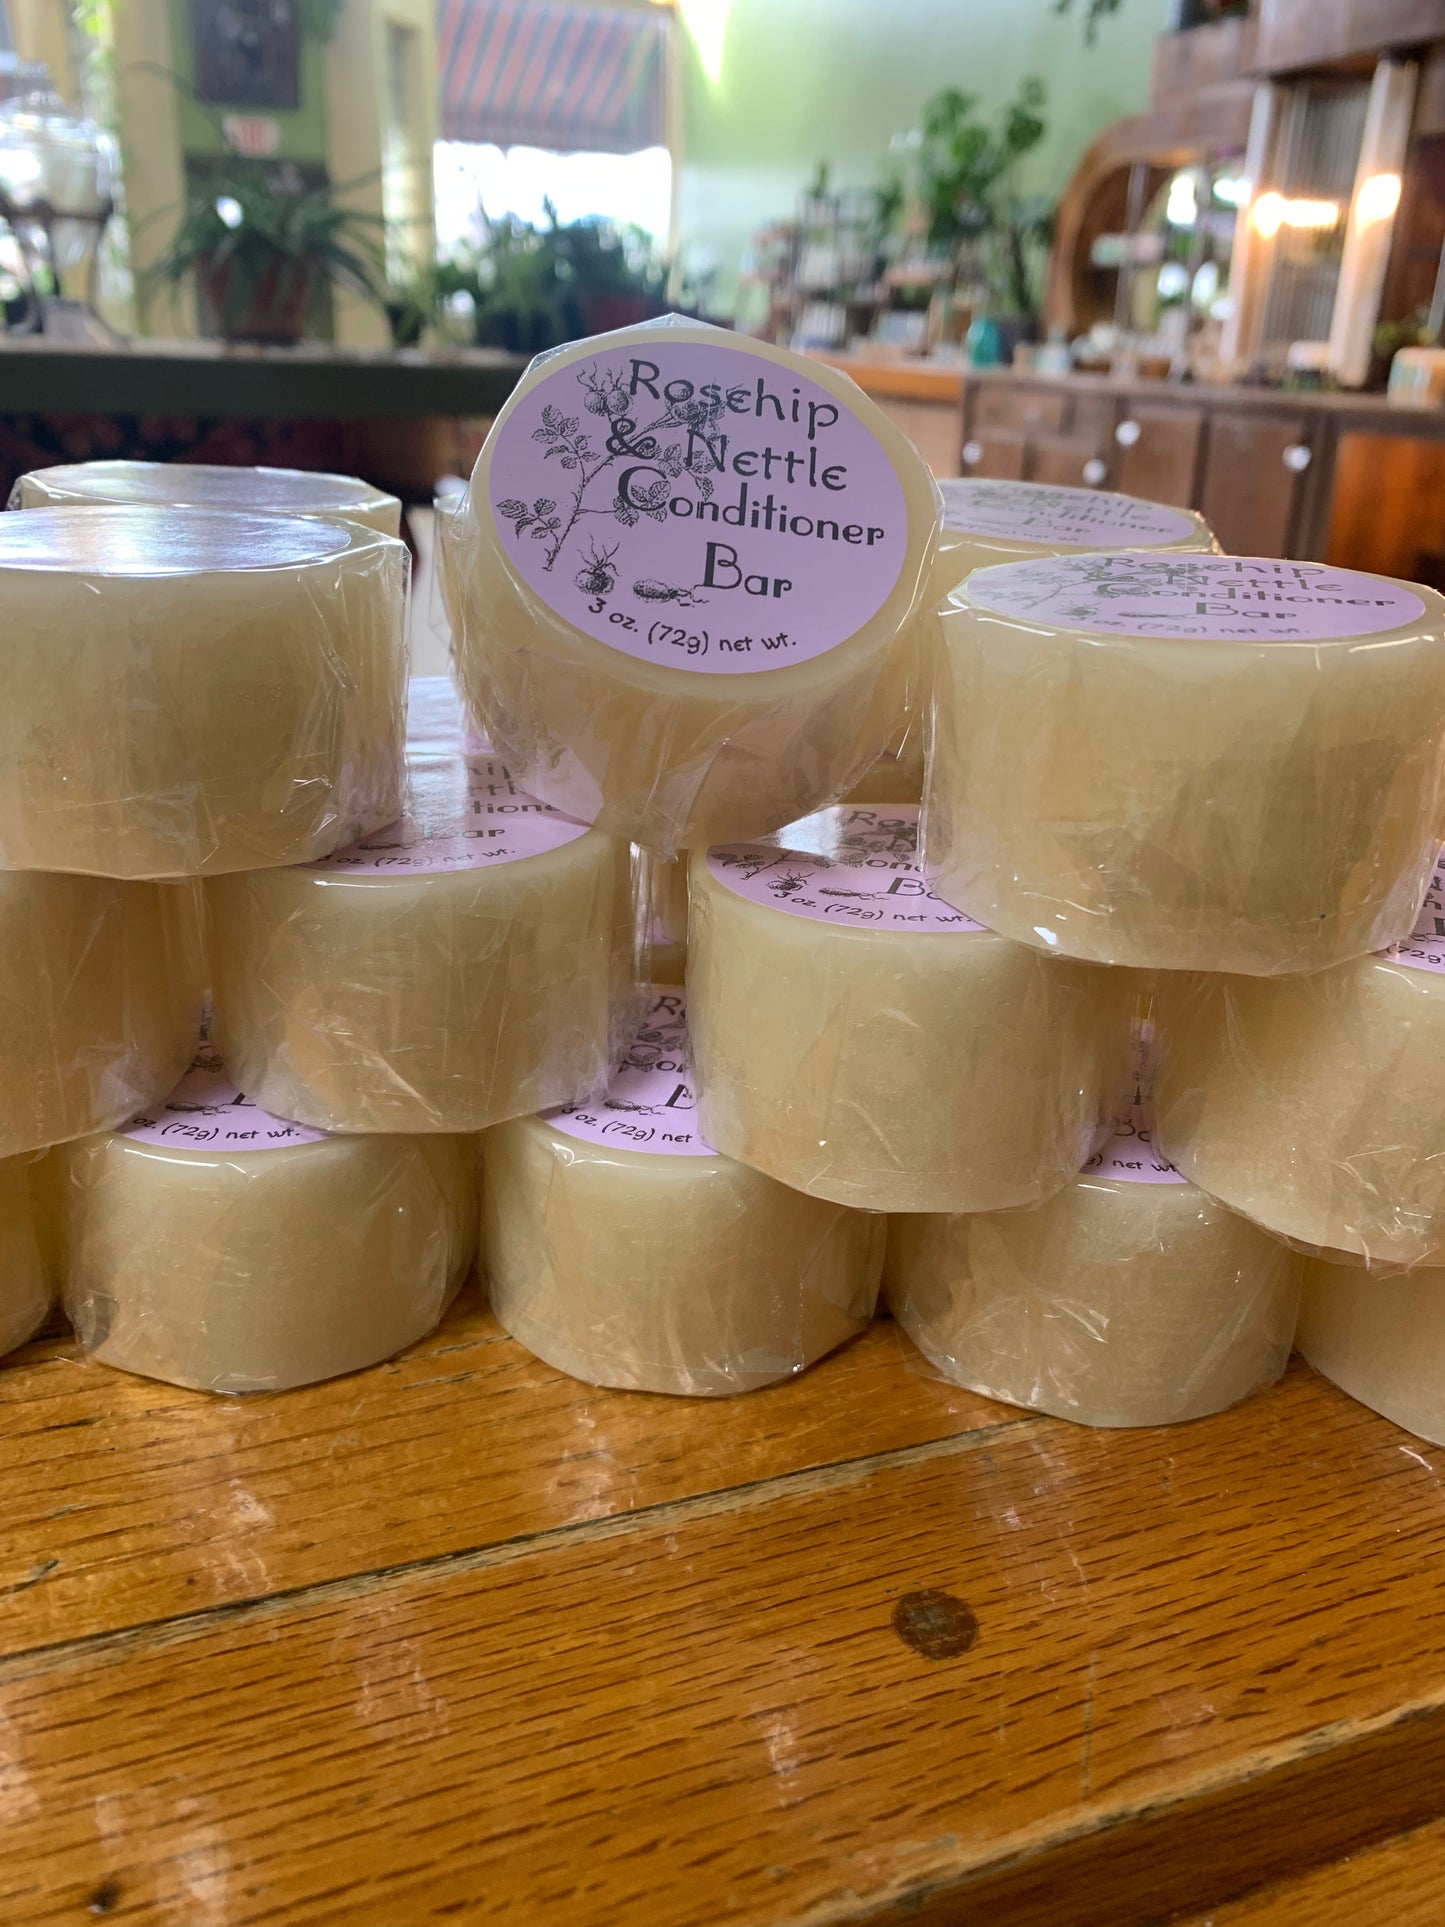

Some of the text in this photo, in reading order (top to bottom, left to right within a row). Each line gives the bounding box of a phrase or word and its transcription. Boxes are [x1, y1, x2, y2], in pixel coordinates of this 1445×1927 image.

[629, 358, 839, 440] Rosehip
[606, 418, 847, 491] & Nettle
[618, 465, 885, 546] Conditioner
[1022, 517, 1092, 533] Bar
[700, 541, 793, 599] Bar
[1104, 557, 1325, 578] Rosehip
[1166, 571, 1344, 592] Nettle
[1096, 582, 1396, 606] Conditioner
[1196, 602, 1297, 619] Bar
[588, 598, 797, 656] 3 oz. (72g) net wt.
[824, 903, 884, 920] (72g)
[893, 914, 928, 922] net
[1386, 943, 1445, 965] (72g
[160, 1122, 220, 1141] (72g)
[225, 1130, 260, 1140] net
[267, 1128, 301, 1139] wt.
[575, 1114, 597, 1127] oz.
[601, 1121, 656, 1141] (72g)
[661, 1133, 694, 1143] net
[1113, 1159, 1144, 1170] net
[1151, 1163, 1178, 1173] wt
